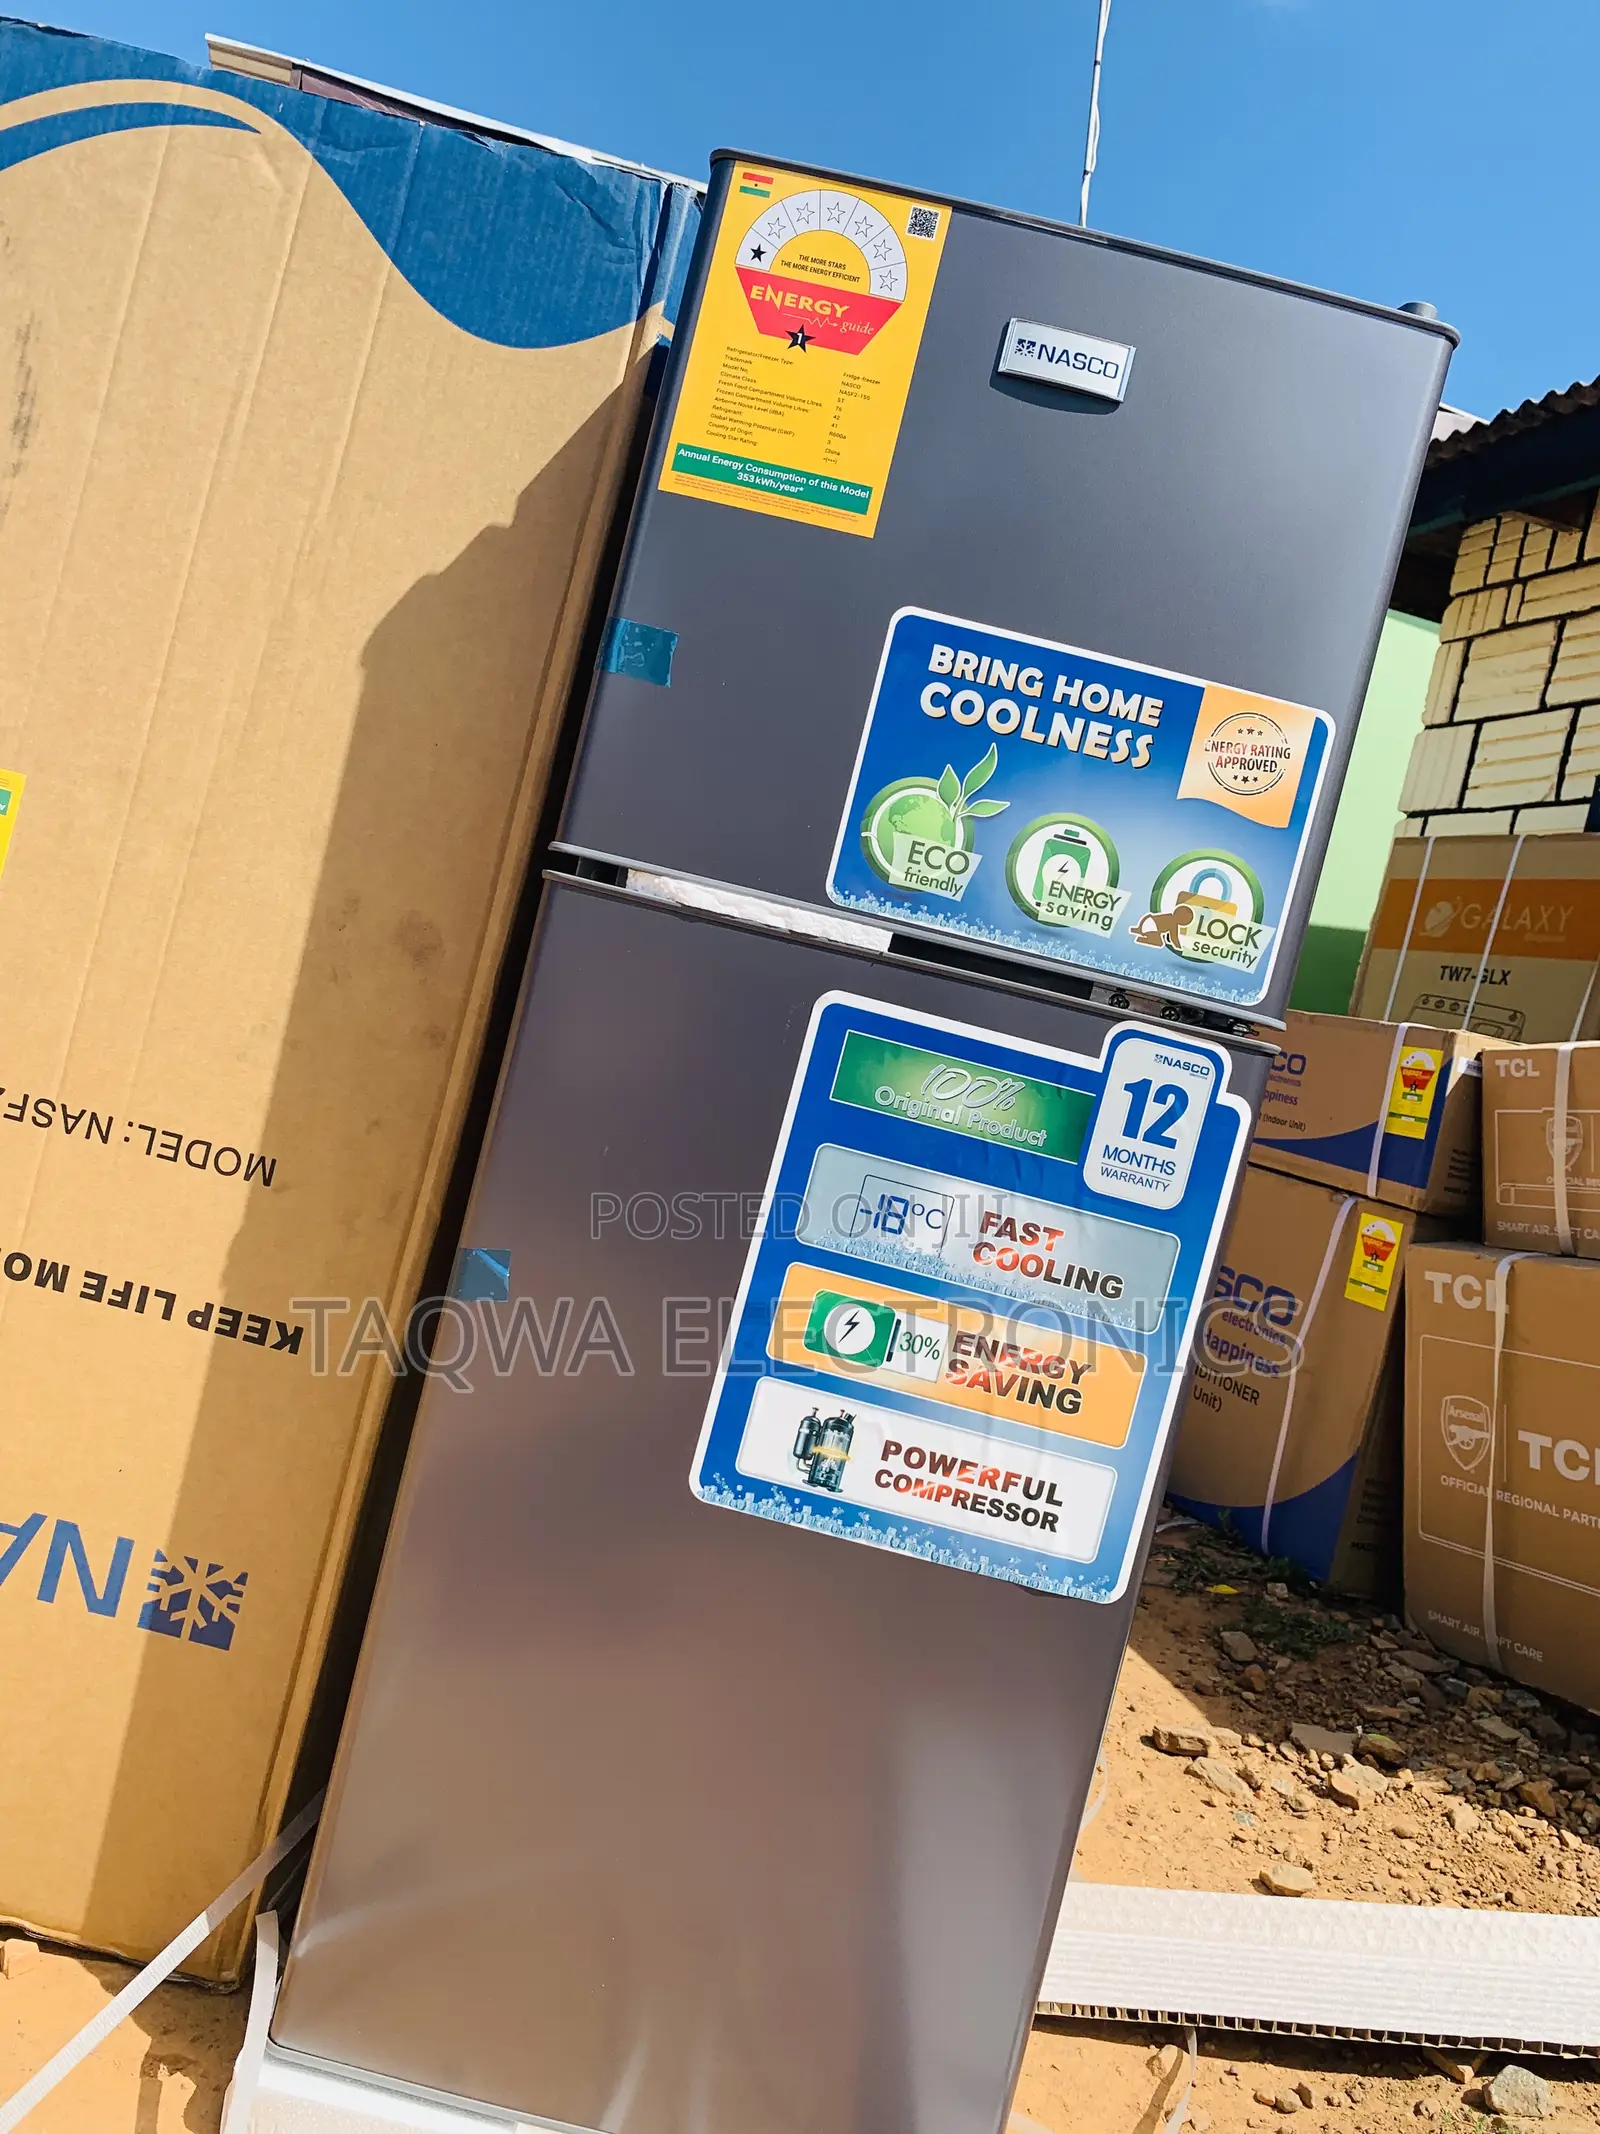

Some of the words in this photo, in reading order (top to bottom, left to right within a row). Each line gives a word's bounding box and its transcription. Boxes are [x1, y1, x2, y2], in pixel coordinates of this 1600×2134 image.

[780, 260, 791, 269] THE
[792, 263, 808, 272] MORE
[809, 267, 832, 277] ENERGY
[832, 272, 860, 283] EFFICIENT
[811, 257, 827, 267] MORE
[828, 261, 847, 270] STARS
[750, 284, 850, 318] ENERGY
[840, 320, 875, 335] guide
[1037, 343, 1119, 379] NASCO
[735, 392, 771, 405] Compartment
[748, 386, 785, 400] Compartment
[678, 448, 711, 462] Annual
[712, 455, 744, 471] Energy
[746, 463, 807, 485] Consumption
[808, 477, 820, 487] of
[820, 480, 838, 492] this
[840, 486, 870, 499] Model
[928, 644, 1044, 698] BRING
[1052, 674, 1164, 728] HOME
[920, 681, 1155, 770] COOLNESS
[1204, 739, 1248, 757] ENERGY
[1250, 743, 1291, 760] RATING
[1215, 755, 1279, 773] APPROVED
[907, 840, 970, 875] ECO
[904, 866, 963, 898] friendly
[1048, 880, 1122, 912] ENERGY
[1045, 900, 1114, 931] saving
[1195, 914, 1263, 950] LOCK
[1192, 939, 1258, 969] security
[1162, 1056, 1211, 1076] NASCO
[1495, 1059, 1540, 1077] TCL
[921, 1063, 1026, 1111] 100%
[0, 1087, 114, 1144] NASF
[874, 1085, 964, 1127] Original
[966, 1109, 1048, 1148] Product
[1122, 1077, 1190, 1151] 12
[123, 1120, 277, 1187] MODEL:
[1102, 1144, 1177, 1176] MONTHS
[1100, 1166, 1171, 1193] WARRANTY
[979, 1210, 1065, 1251] FAST
[1496, 1220, 1529, 1234] SMART
[972, 1241, 1124, 1299] COOLING
[79, 1270, 177, 1321] LIFE
[187, 1302, 304, 1355] KEEP
[1222, 1310, 1287, 1345] electronics
[900, 1331, 941, 1361] 30%
[952, 1330, 1092, 1385] ENERGY
[945, 1358, 1083, 1414] SAVING
[1193, 1385, 1222, 1412] Unit)
[1194, 1365, 1260, 1406] DITIONER
[1448, 1405, 1485, 1424] Arsenal
[880, 1439, 1064, 1508] POWERFUL
[874, 1468, 1060, 1533] COMPRESSOR
[1496, 1490, 1560, 1518] REGIONAL
[1428, 1609, 1461, 1630] SMART
[1514, 1642, 1544, 1662] CARE
